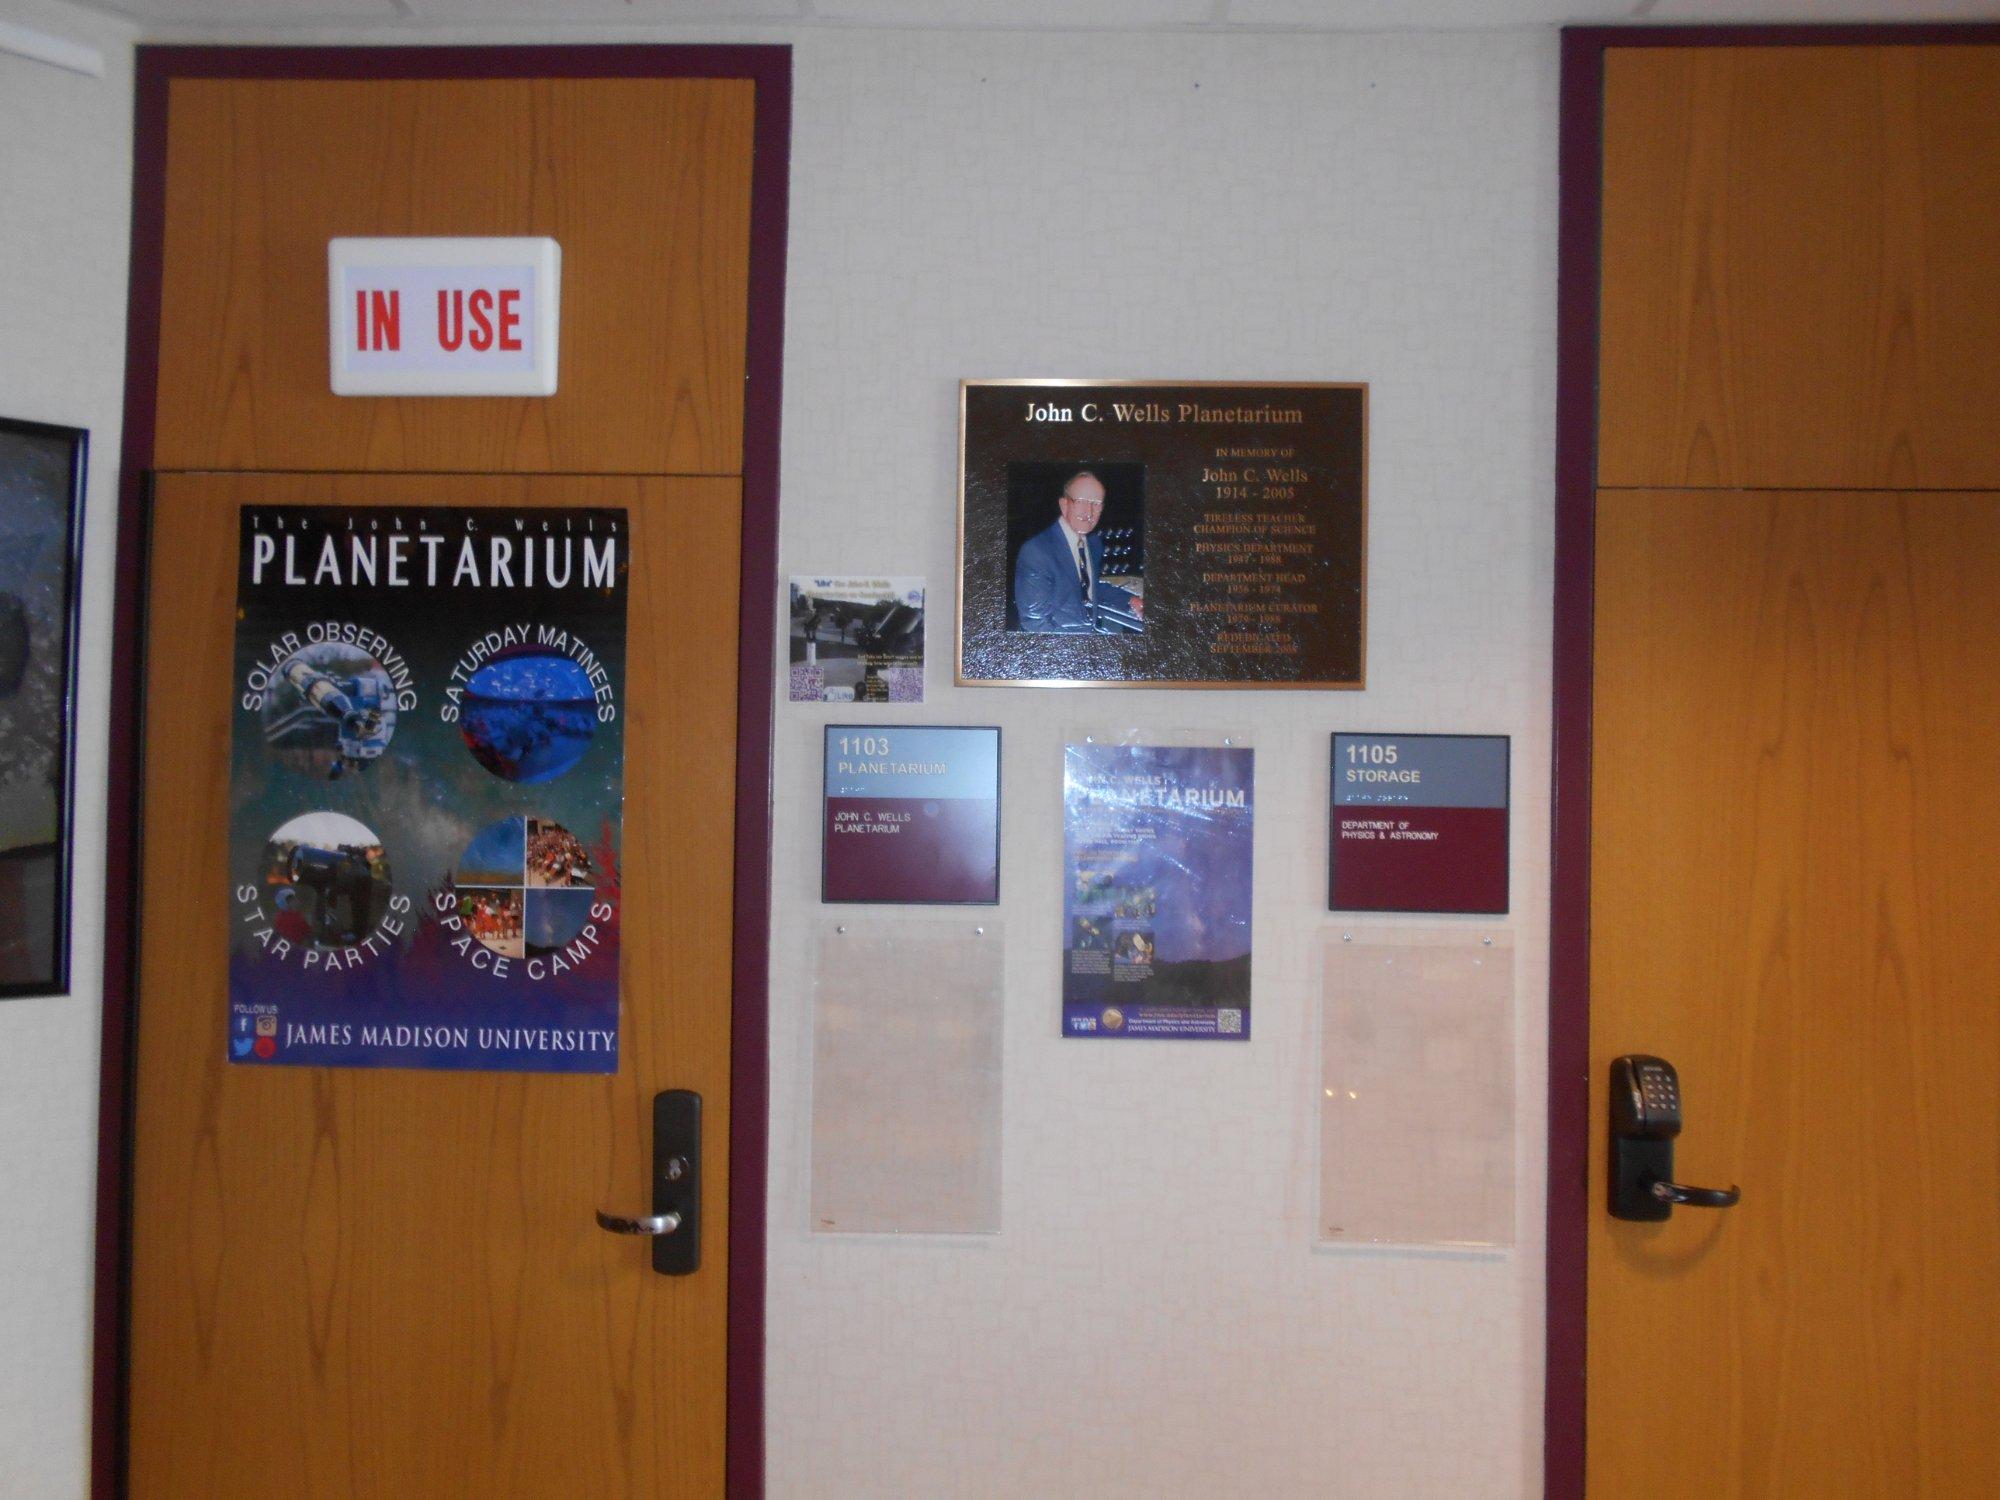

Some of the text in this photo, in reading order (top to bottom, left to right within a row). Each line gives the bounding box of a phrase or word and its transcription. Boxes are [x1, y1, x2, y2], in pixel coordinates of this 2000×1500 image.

[356, 289, 522, 352] IN USE
[1025, 402, 1304, 425] John C. Wells Planetarium
[1215, 447, 1294, 458] IN MEMORY OF
[1202, 468, 1308, 483] John C. Wells
[1216, 486, 1248, 499] 1914
[252, 515, 309, 530] The
[347, 517, 427, 531] John
[514, 518, 617, 533] Wells
[1193, 525, 1251, 534] CHAMPION
[1270, 525, 1317, 536] SCIENCE
[252, 534, 616, 589] PLANETARIUM
[242, 621, 418, 713] SOLAR OBSERVING
[440, 623, 616, 724] SATURDAY MATINEES
[839, 736, 890, 756] 1103
[1346, 744, 1398, 765] 1105
[838, 762, 947, 776] PLANETARIUM
[1345, 768, 1421, 784] STORAGE
[834, 811, 912, 823] JOHN C. WELLS
[1341, 820, 1410, 831] DEPARTMENT OF
[833, 824, 901, 834] PLANETARIUM
[1341, 831, 1440, 841] PHYSICS & ASTRONOMY
[236, 882, 412, 972] STAR PARTIES
[435, 891, 612, 981] SPACE CAMPS
[233, 1004, 266, 1015] FOLLOW
[285, 1022, 615, 1052] JAMES MADISON UNIVERSITY
